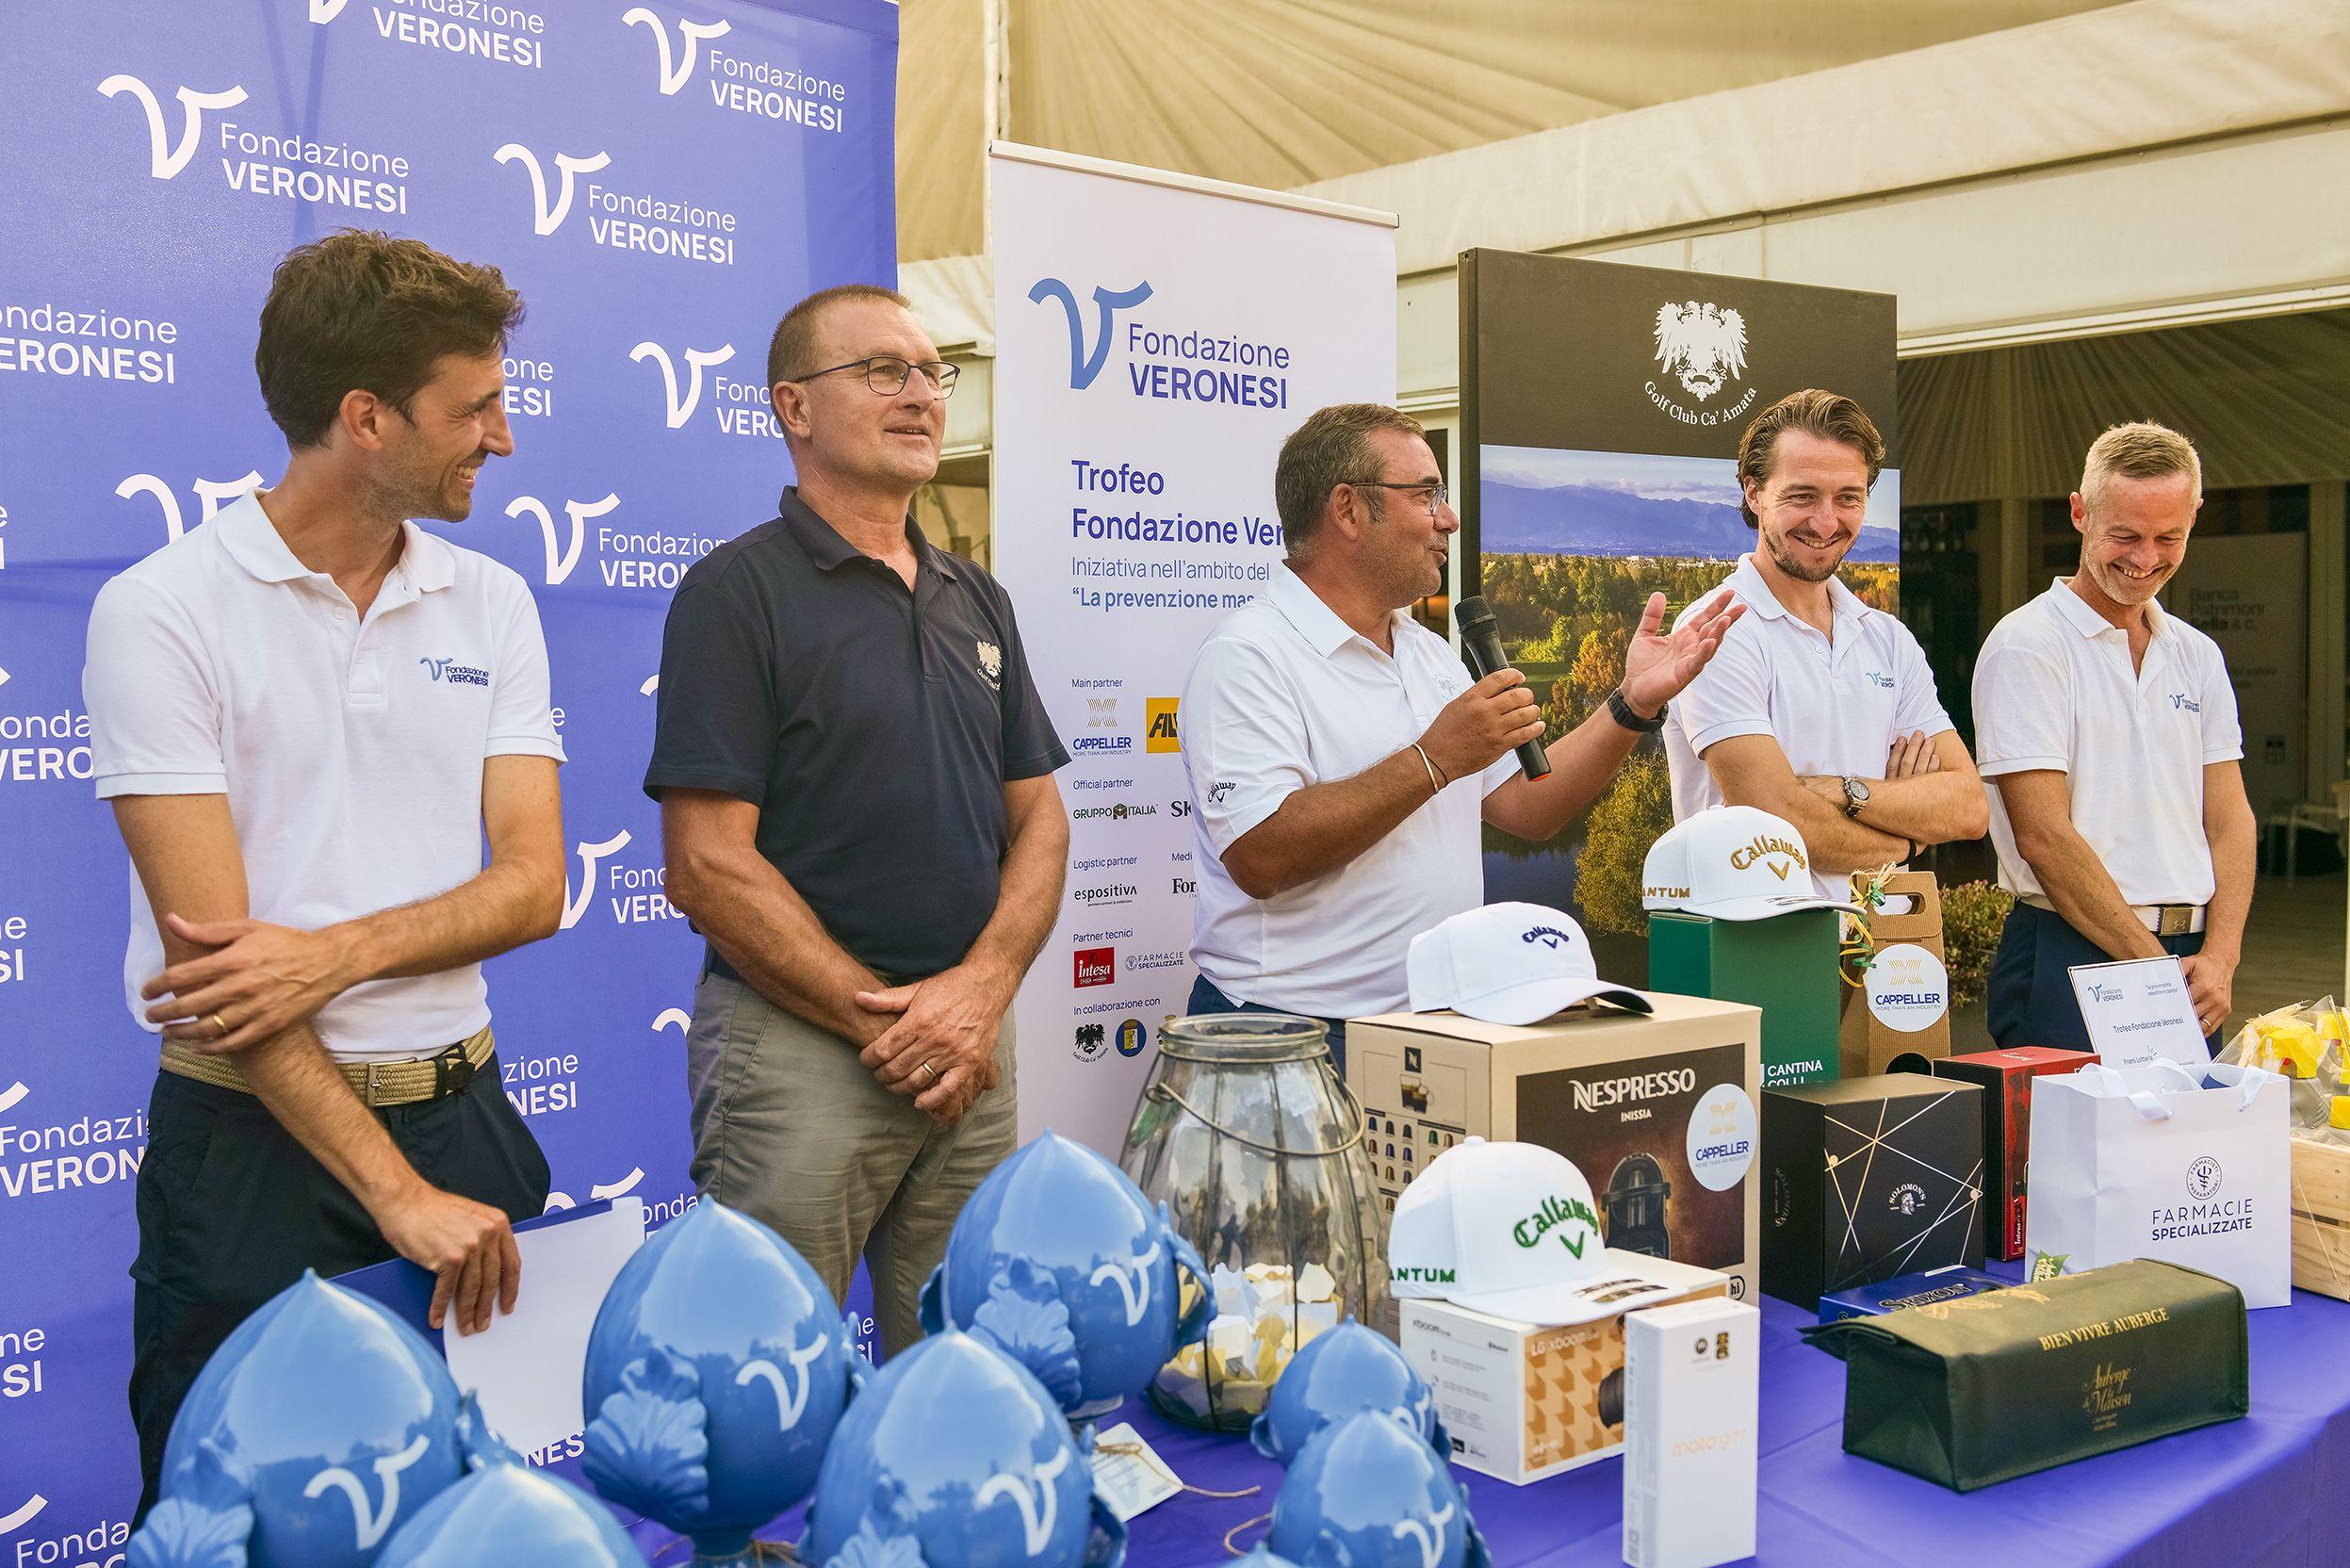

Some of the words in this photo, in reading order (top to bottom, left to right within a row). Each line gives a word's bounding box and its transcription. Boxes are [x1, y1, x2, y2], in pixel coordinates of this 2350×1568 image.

[373, 7, 542, 68] VERONESI
[710, 49, 845, 101] Fondazione
[710, 79, 841, 133] VERONESI
[220, 122, 409, 177] Fondazione
[221, 158, 406, 214] VERONESI
[589, 185, 736, 232] Fondazione
[589, 216, 733, 265] VERONESI
[0, 303, 177, 344] ndazione
[1130, 323, 1290, 368] Fondazione
[0, 338, 175, 384] ERONESI
[1129, 363, 1287, 409] VERONESI
[1644, 381, 1670, 411] Golf
[1669, 404, 1698, 425] Club
[1723, 386, 1757, 423] Amata
[1071, 460, 1164, 496] Trofeo
[1072, 509, 1237, 544] Fondazione
[1243, 517, 1283, 547] Ver
[1072, 556, 1147, 579] Iniziativa
[1247, 563, 1270, 580] del
[1104, 589, 1218, 612] prevenzione
[446, 666, 489, 678] Fondazione
[447, 675, 488, 686] VERONESI
[1071, 678, 1092, 688] Main
[1093, 679, 1123, 690] partner
[1072, 737, 1132, 750] CAPPELLER
[1073, 779, 1102, 790] Official
[1103, 778, 1134, 791] partner
[1074, 858, 1106, 871] Logistic
[1107, 856, 1137, 869] partner
[1171, 853, 1193, 861] Medi
[1730, 835, 1807, 870] Callaway
[1172, 877, 1199, 894] For
[1073, 931, 1103, 943] Partner
[1104, 928, 1134, 940] tecnici
[1138, 952, 1183, 962] FARMACIE
[1138, 959, 1184, 970] SPECIALIZZATE
[1073, 1006, 1081, 1016] In
[1083, 1000, 1143, 1015] collaborazione
[1144, 998, 1160, 1007] con
[1876, 993, 1940, 1005] CAPPELLER
[2113, 1025, 2131, 1034] Trofeo
[2131, 1020, 2162, 1033] Fondazione
[2162, 1016, 2184, 1026] Veronesi
[1768, 1060, 1823, 1077] CANTINA
[1568, 1068, 1696, 1113] NESPRESSO
[1621, 1109, 1652, 1122] INISSIA
[1696, 1141, 1749, 1161] CAPPELLER
[0, 1145, 141, 1198] VERON
[1514, 1195, 1600, 1249] Callaway
[2152, 1199, 2252, 1225] FARMACIE
[2152, 1217, 2252, 1241] SPECIALIZZATE
[2038, 1331, 2073, 1351] BIEN
[2071, 1321, 2113, 1342] VIVRE
[2113, 1308, 2169, 1333] AUBERGE
